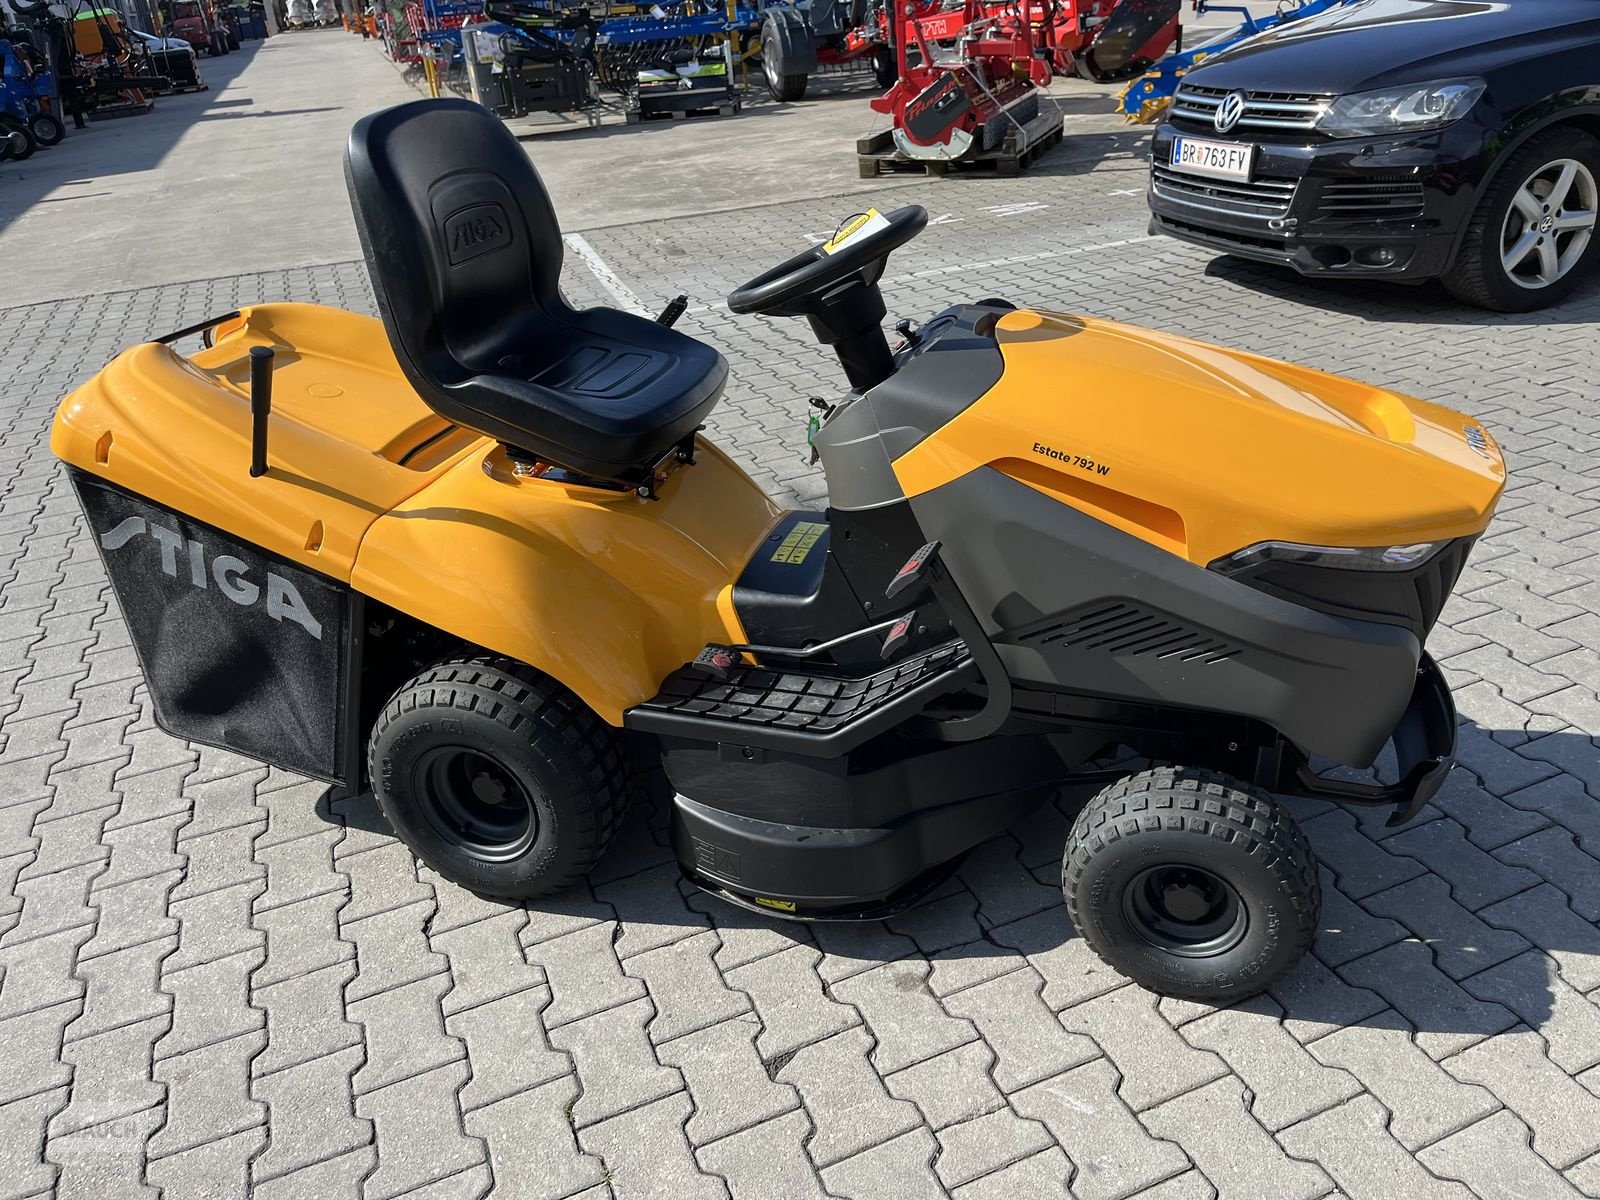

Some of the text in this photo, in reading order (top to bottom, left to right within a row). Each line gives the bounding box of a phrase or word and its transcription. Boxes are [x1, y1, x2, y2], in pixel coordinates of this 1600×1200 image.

[1182, 143, 1196, 164] BR
[1203, 146, 1227, 168] 763
[1032, 442, 1111, 476] Estate 792 W
[100, 515, 323, 641] STIGA
